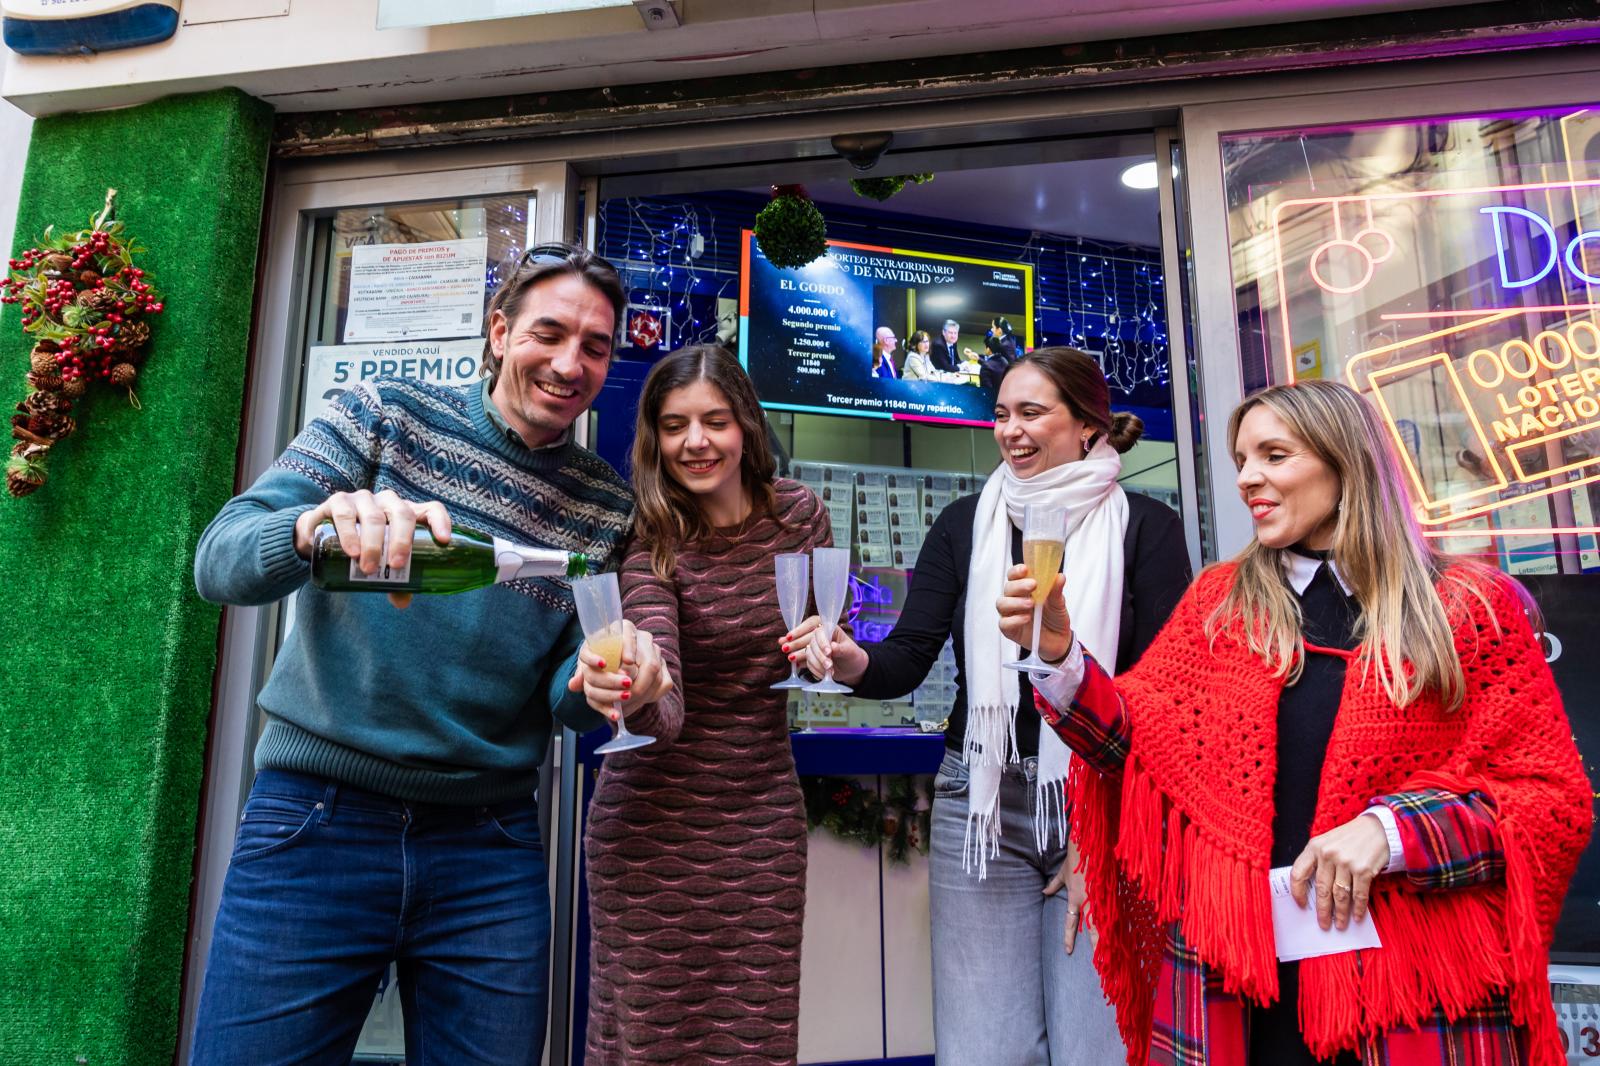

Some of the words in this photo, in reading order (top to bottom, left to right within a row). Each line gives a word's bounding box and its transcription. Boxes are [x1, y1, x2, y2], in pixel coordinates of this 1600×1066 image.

[829, 253, 868, 264] SORTEO
[870, 257, 954, 275] EXTRAORDINARIO
[854, 265, 872, 277] DE
[874, 267, 931, 284] NAVIDAD
[780, 279, 797, 291] EL
[799, 281, 845, 296] GORDO
[788, 305, 829, 317] 4.000.000
[829, 309, 837, 318] €
[782, 318, 814, 329] Segundo
[815, 323, 841, 332] premio
[373, 347, 413, 356] VENDIDO
[416, 346, 440, 355] AQUÍ
[793, 337, 824, 348] 1.250.000
[787, 348, 810, 358] Tercer
[811, 352, 836, 361] premio
[360, 356, 476, 381] PREMIO
[827, 394, 853, 404] Tercer
[854, 398, 883, 408] premio
[884, 399, 907, 409] 11840
[908, 402, 925, 412] muy
[927, 402, 964, 415] repartido.
[1491, 392, 1600, 442] NACIO
